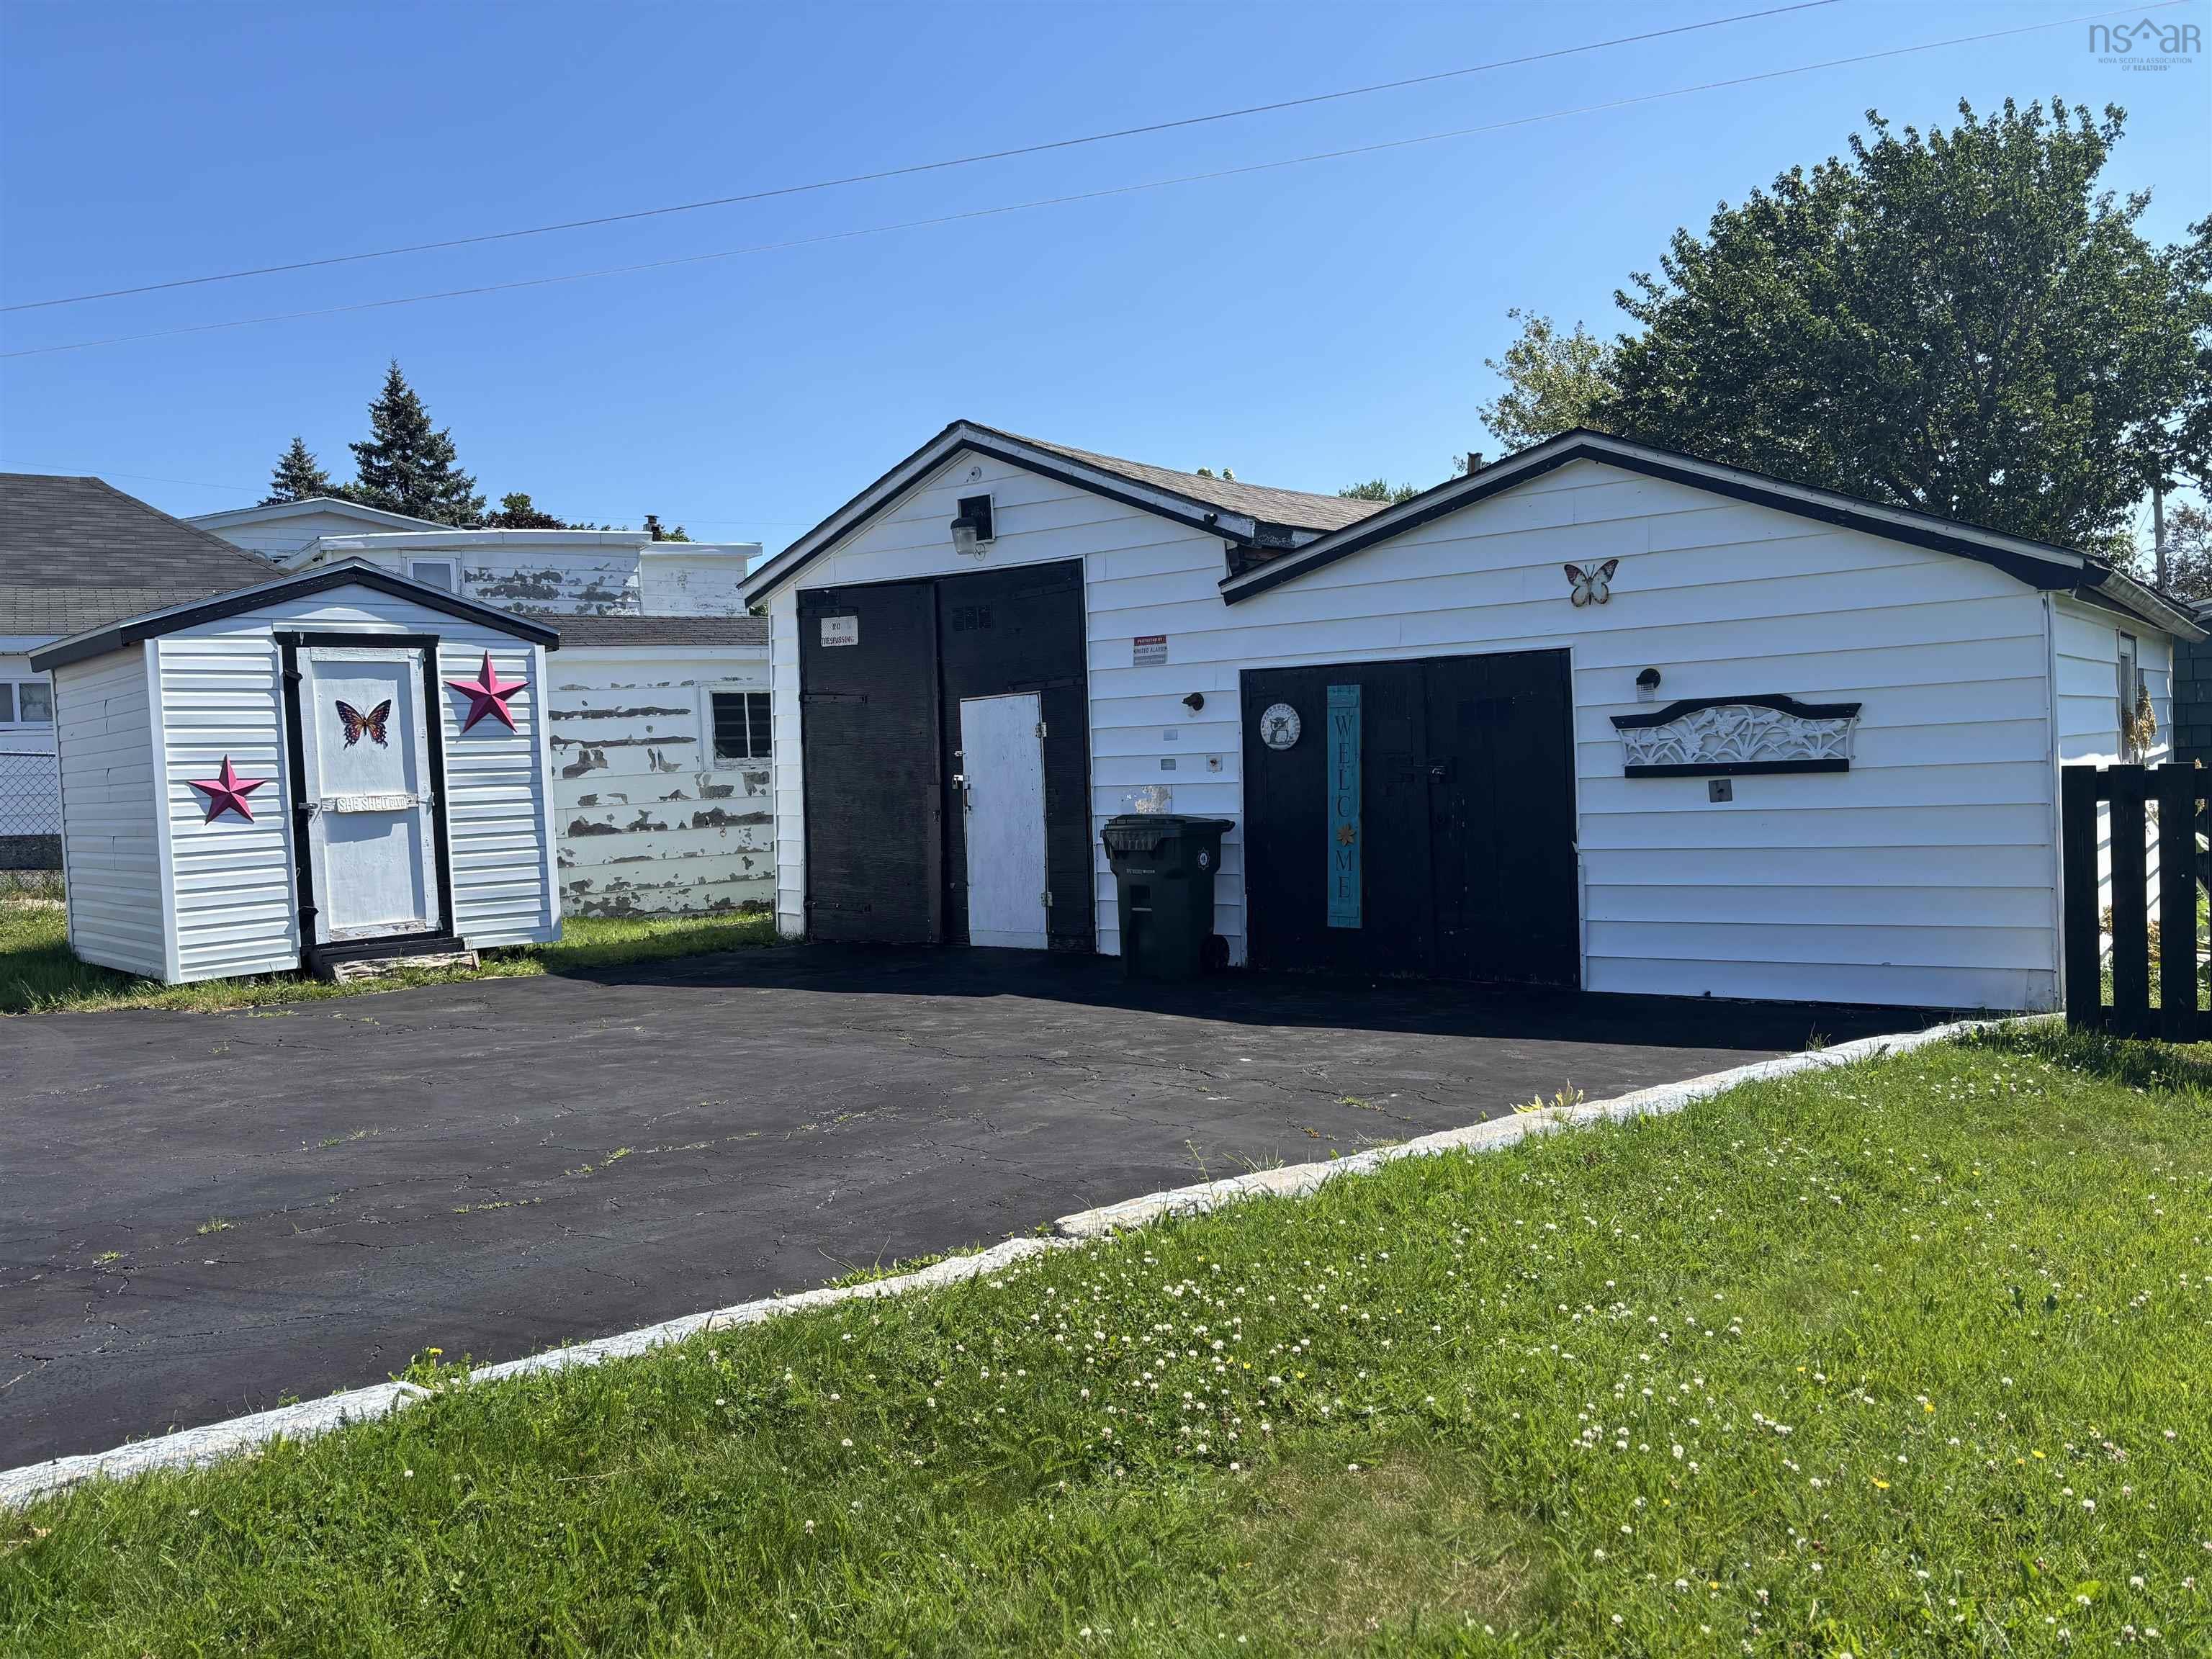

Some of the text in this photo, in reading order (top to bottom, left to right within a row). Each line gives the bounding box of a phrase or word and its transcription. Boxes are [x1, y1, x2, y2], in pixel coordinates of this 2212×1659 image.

[821, 636, 855, 646] TRESPASSING
[338, 799, 359, 812] SHE
[1334, 714, 1354, 899] WELCME
